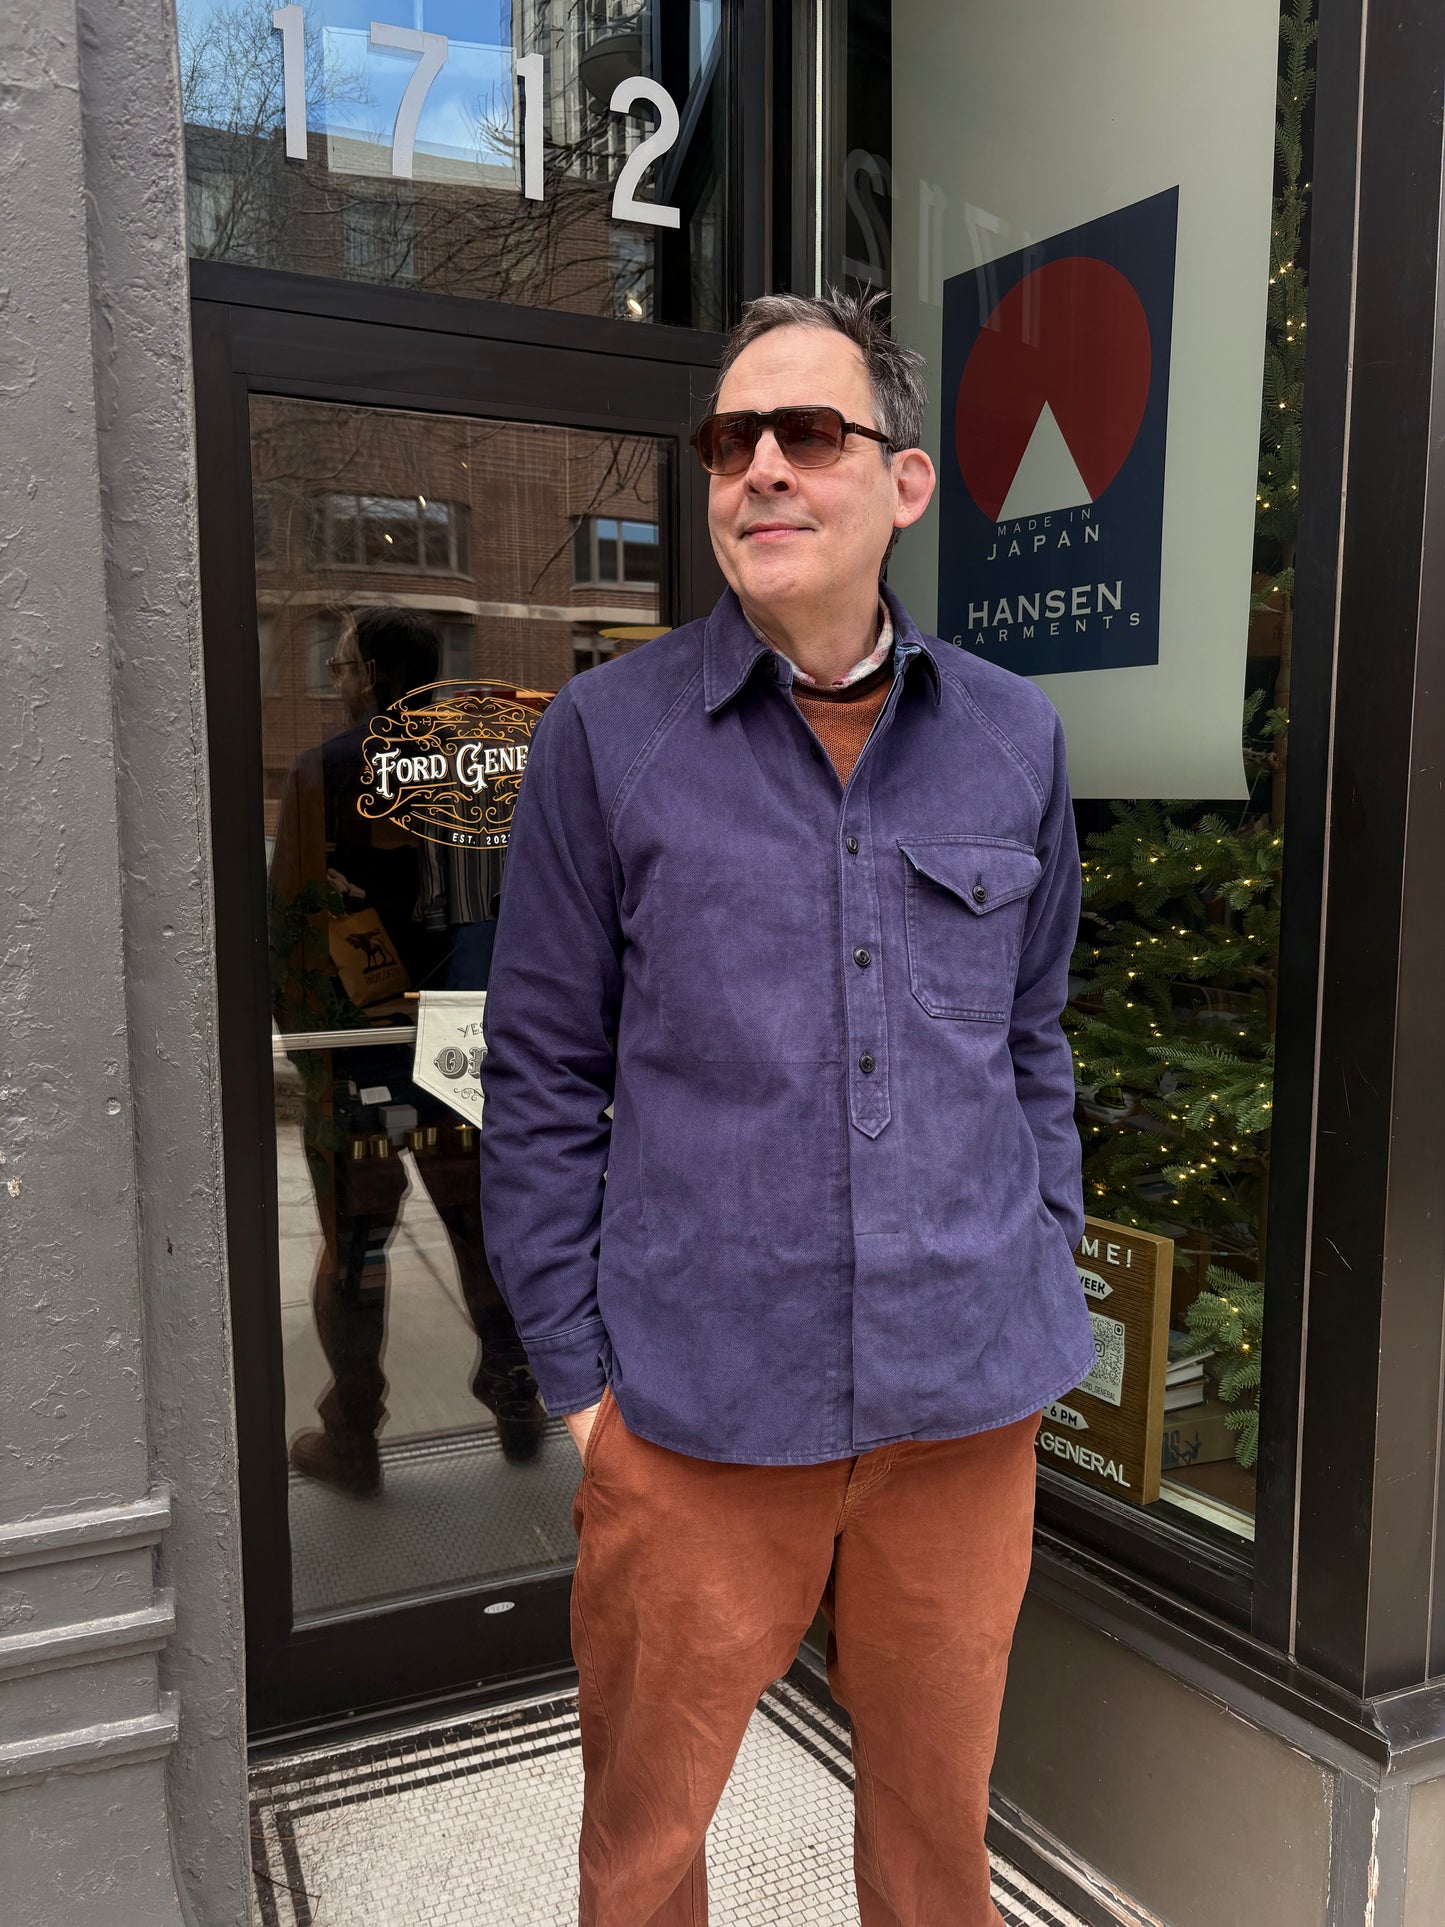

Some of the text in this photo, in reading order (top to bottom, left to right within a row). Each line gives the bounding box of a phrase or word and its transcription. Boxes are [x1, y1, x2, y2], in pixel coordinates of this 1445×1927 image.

[273, 4, 681, 229] 1712
[997, 508, 1091, 537] MADE IN
[987, 524, 1099, 560] JAPAN
[968, 580, 1122, 630] HANSEN
[953, 612, 1140, 647] GARMENTS
[372, 748, 449, 799] FORD
[452, 832, 511, 846] EST. 202
[1050, 1405, 1077, 1426] 6 PM
[1040, 1431, 1131, 1488] GENERAL
